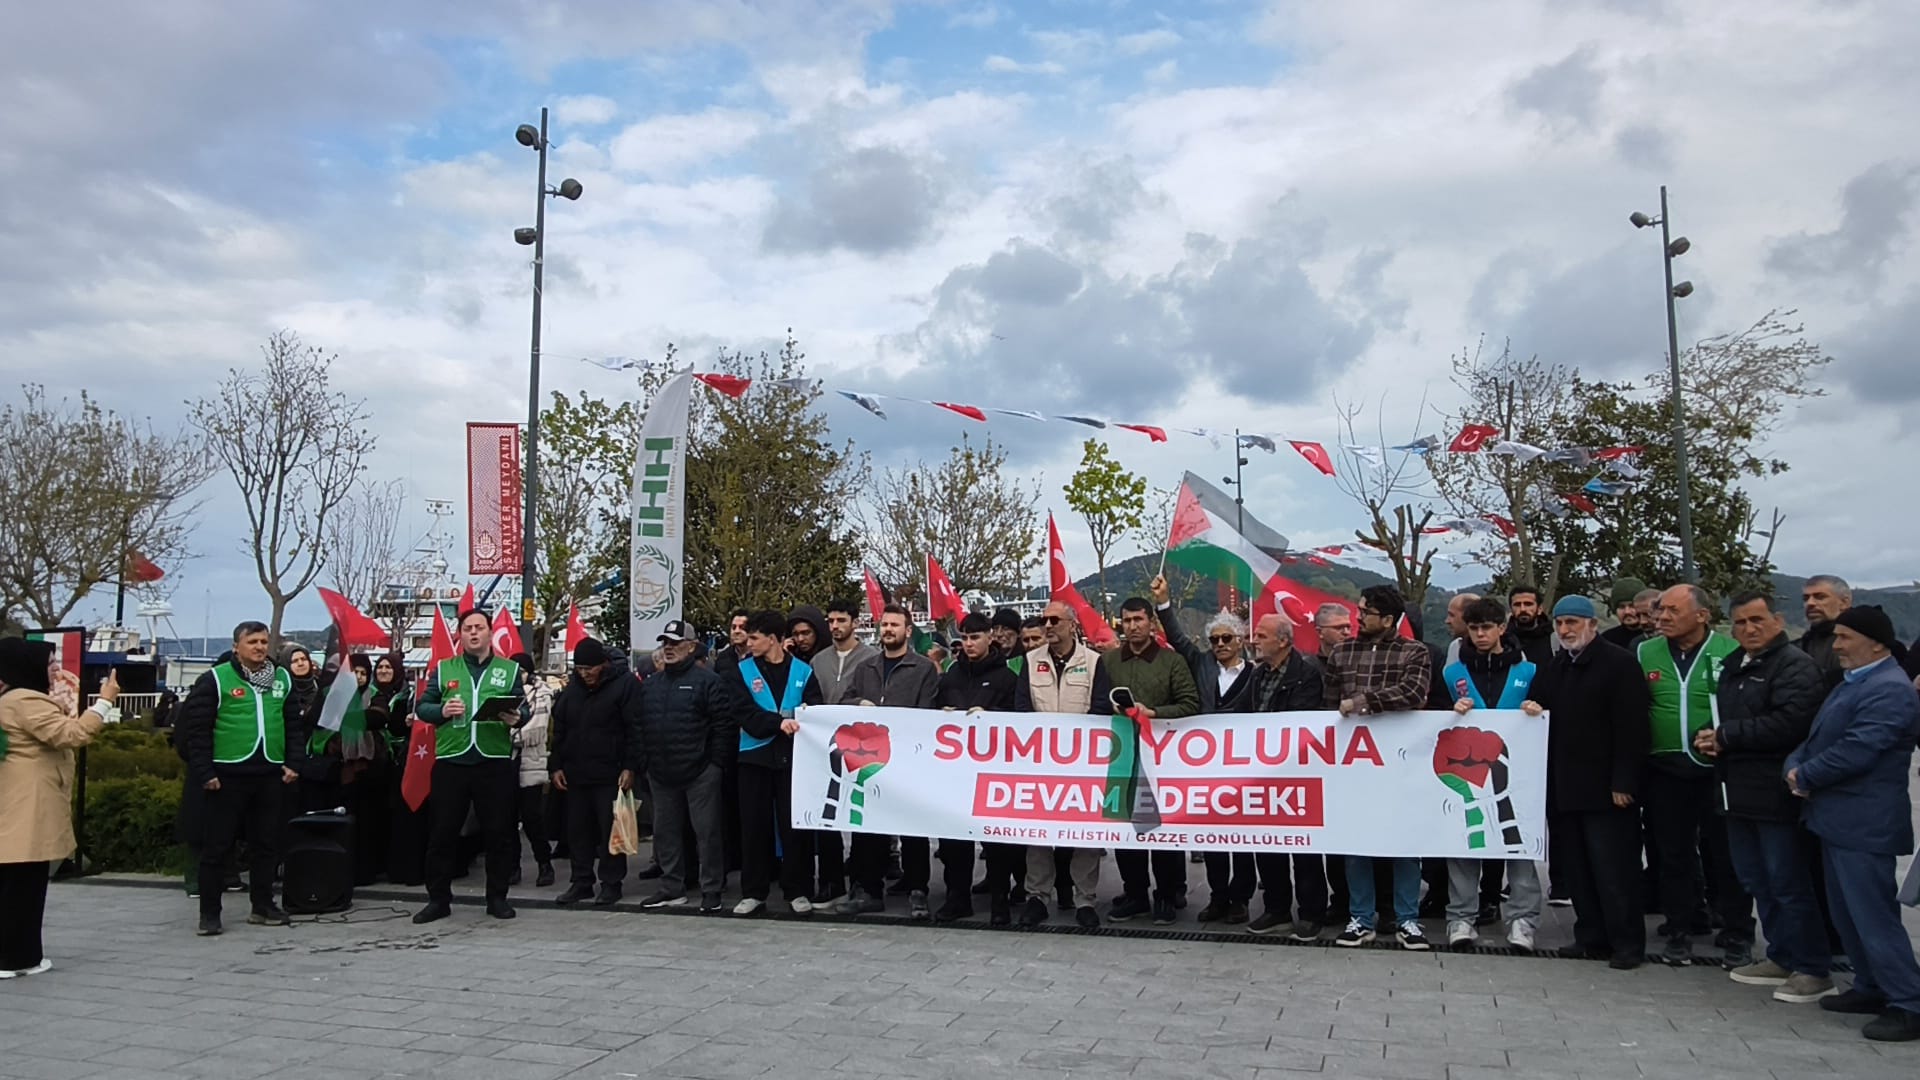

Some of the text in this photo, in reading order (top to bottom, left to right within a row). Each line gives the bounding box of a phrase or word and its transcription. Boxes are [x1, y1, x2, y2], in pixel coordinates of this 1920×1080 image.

[501, 436, 512, 564] SARIYER MEYDANI
[934, 723, 1385, 767] SUMUD YOLUNA
[986, 781, 1306, 816] DEVAM EDECEK!
[983, 824, 1047, 839] SARIYER
[1057, 827, 1121, 842] FİLİSTİN
[1135, 832, 1188, 844] GAZZE
[1194, 833, 1311, 847] GÖNÜLLÜLERİ
